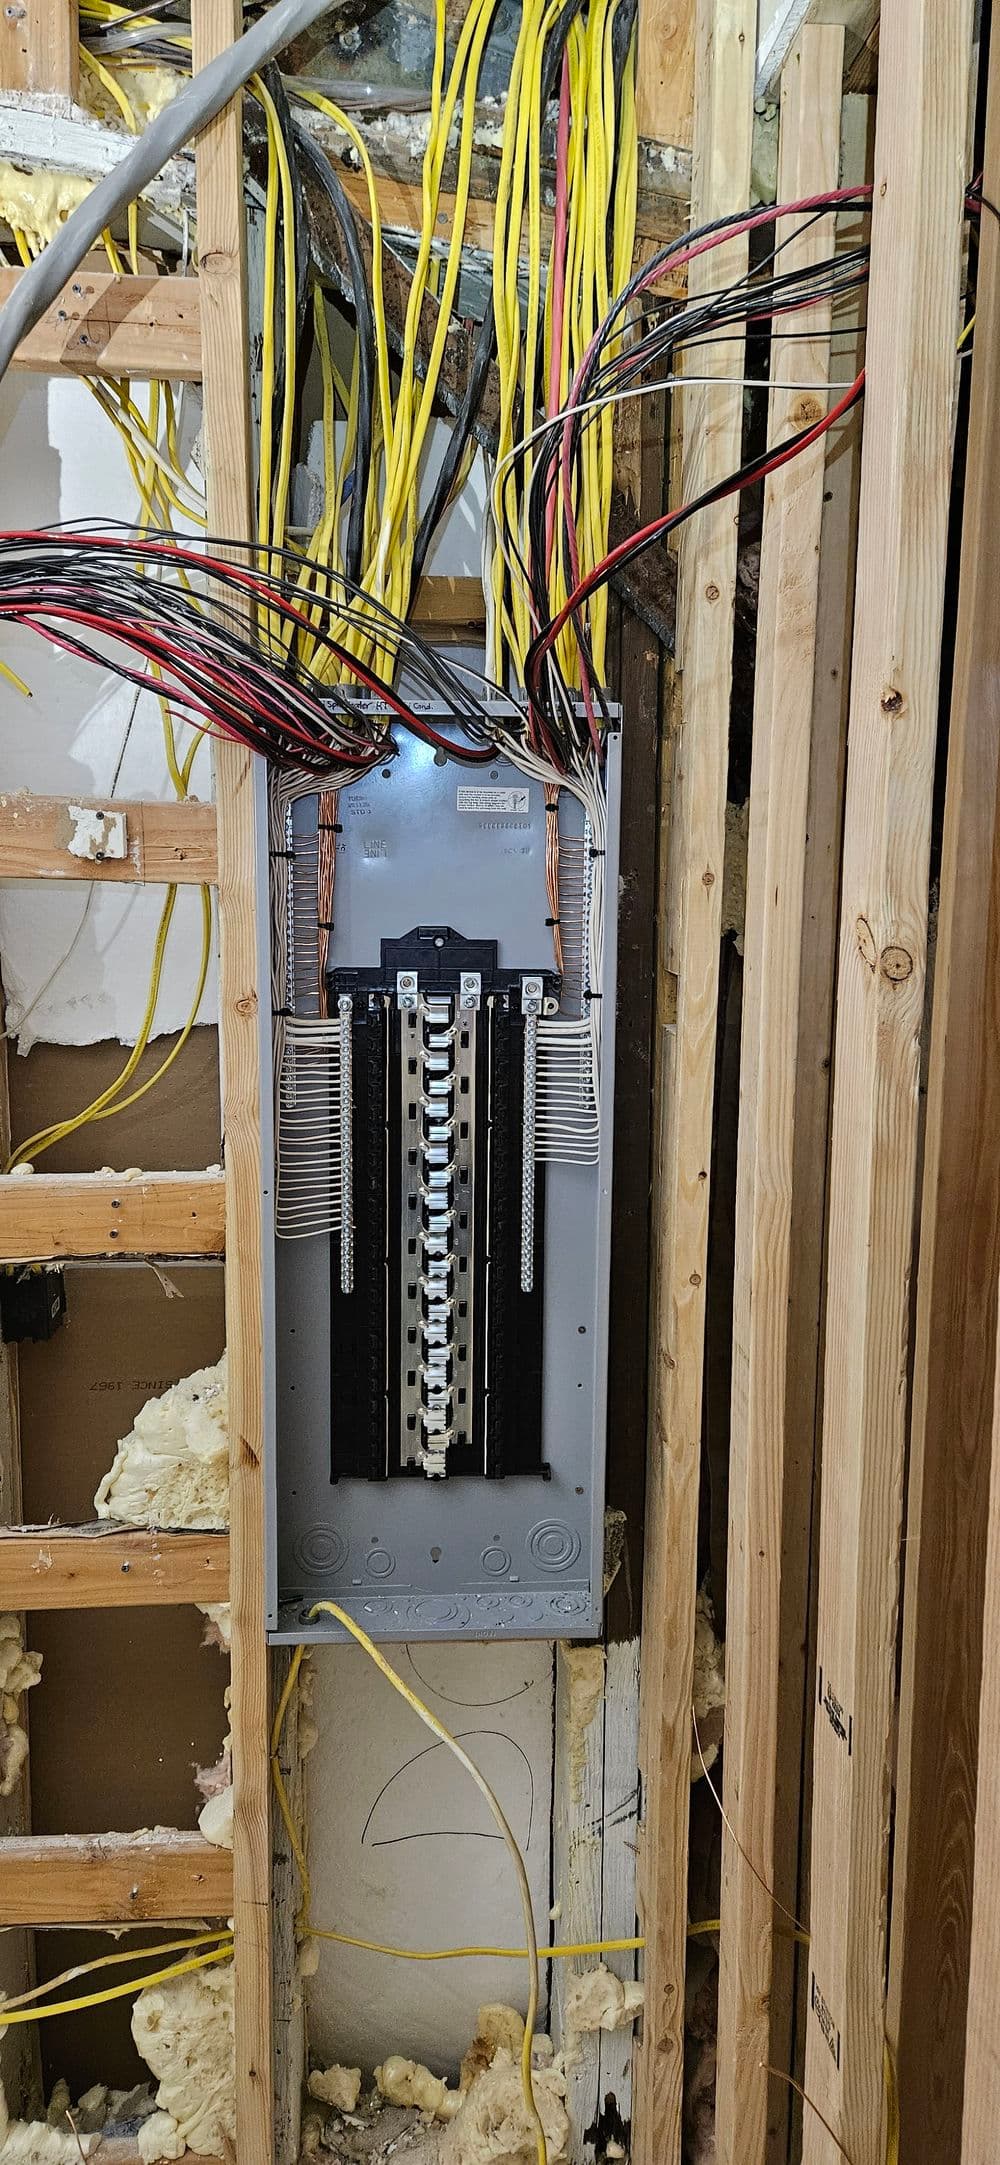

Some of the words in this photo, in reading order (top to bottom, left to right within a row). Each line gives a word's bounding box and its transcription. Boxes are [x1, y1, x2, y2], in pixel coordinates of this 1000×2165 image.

[363, 840, 387, 849] LINE
[89, 1381, 122, 1392] 1967
[132, 1380, 173, 1390] SINCE
